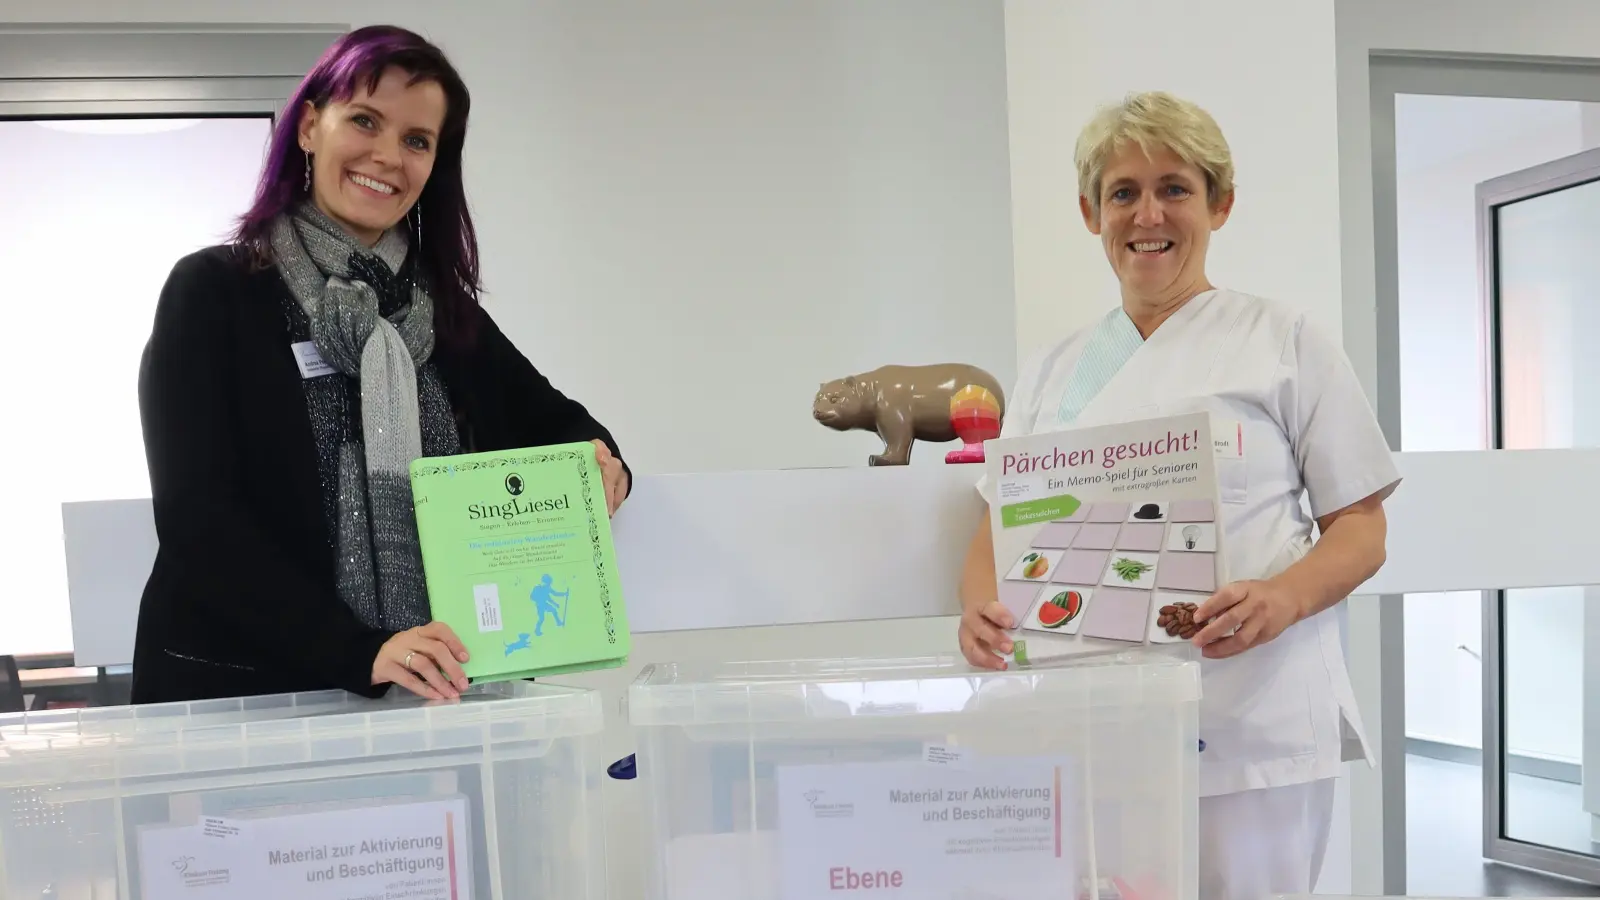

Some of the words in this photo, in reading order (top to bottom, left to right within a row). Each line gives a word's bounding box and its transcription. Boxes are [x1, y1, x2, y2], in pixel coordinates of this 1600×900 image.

[1002, 446, 1094, 475] Pärchen
[1102, 430, 1198, 468] gesucht!
[1048, 478, 1063, 489] Ein
[1067, 468, 1130, 487] Memo-Spiel
[1132, 466, 1149, 481] für
[1152, 461, 1198, 475] Senioren
[1112, 485, 1125, 493] mit
[1126, 479, 1170, 491] extragroßen
[1172, 475, 1197, 484] Karten
[468, 494, 570, 520] SingLiesel
[507, 519, 530, 527] Erleben
[889, 788, 943, 804] Material
[947, 789, 968, 801] zur
[972, 787, 1051, 801] Aktivierung
[923, 808, 948, 821] und
[953, 805, 1051, 821] Beschäftigung
[269, 845, 328, 865] Material
[332, 844, 356, 858] zur
[359, 836, 443, 855] Aktivierung
[306, 866, 335, 882] und
[339, 856, 444, 879] Beschäftigung
[829, 866, 903, 890] Ebene
